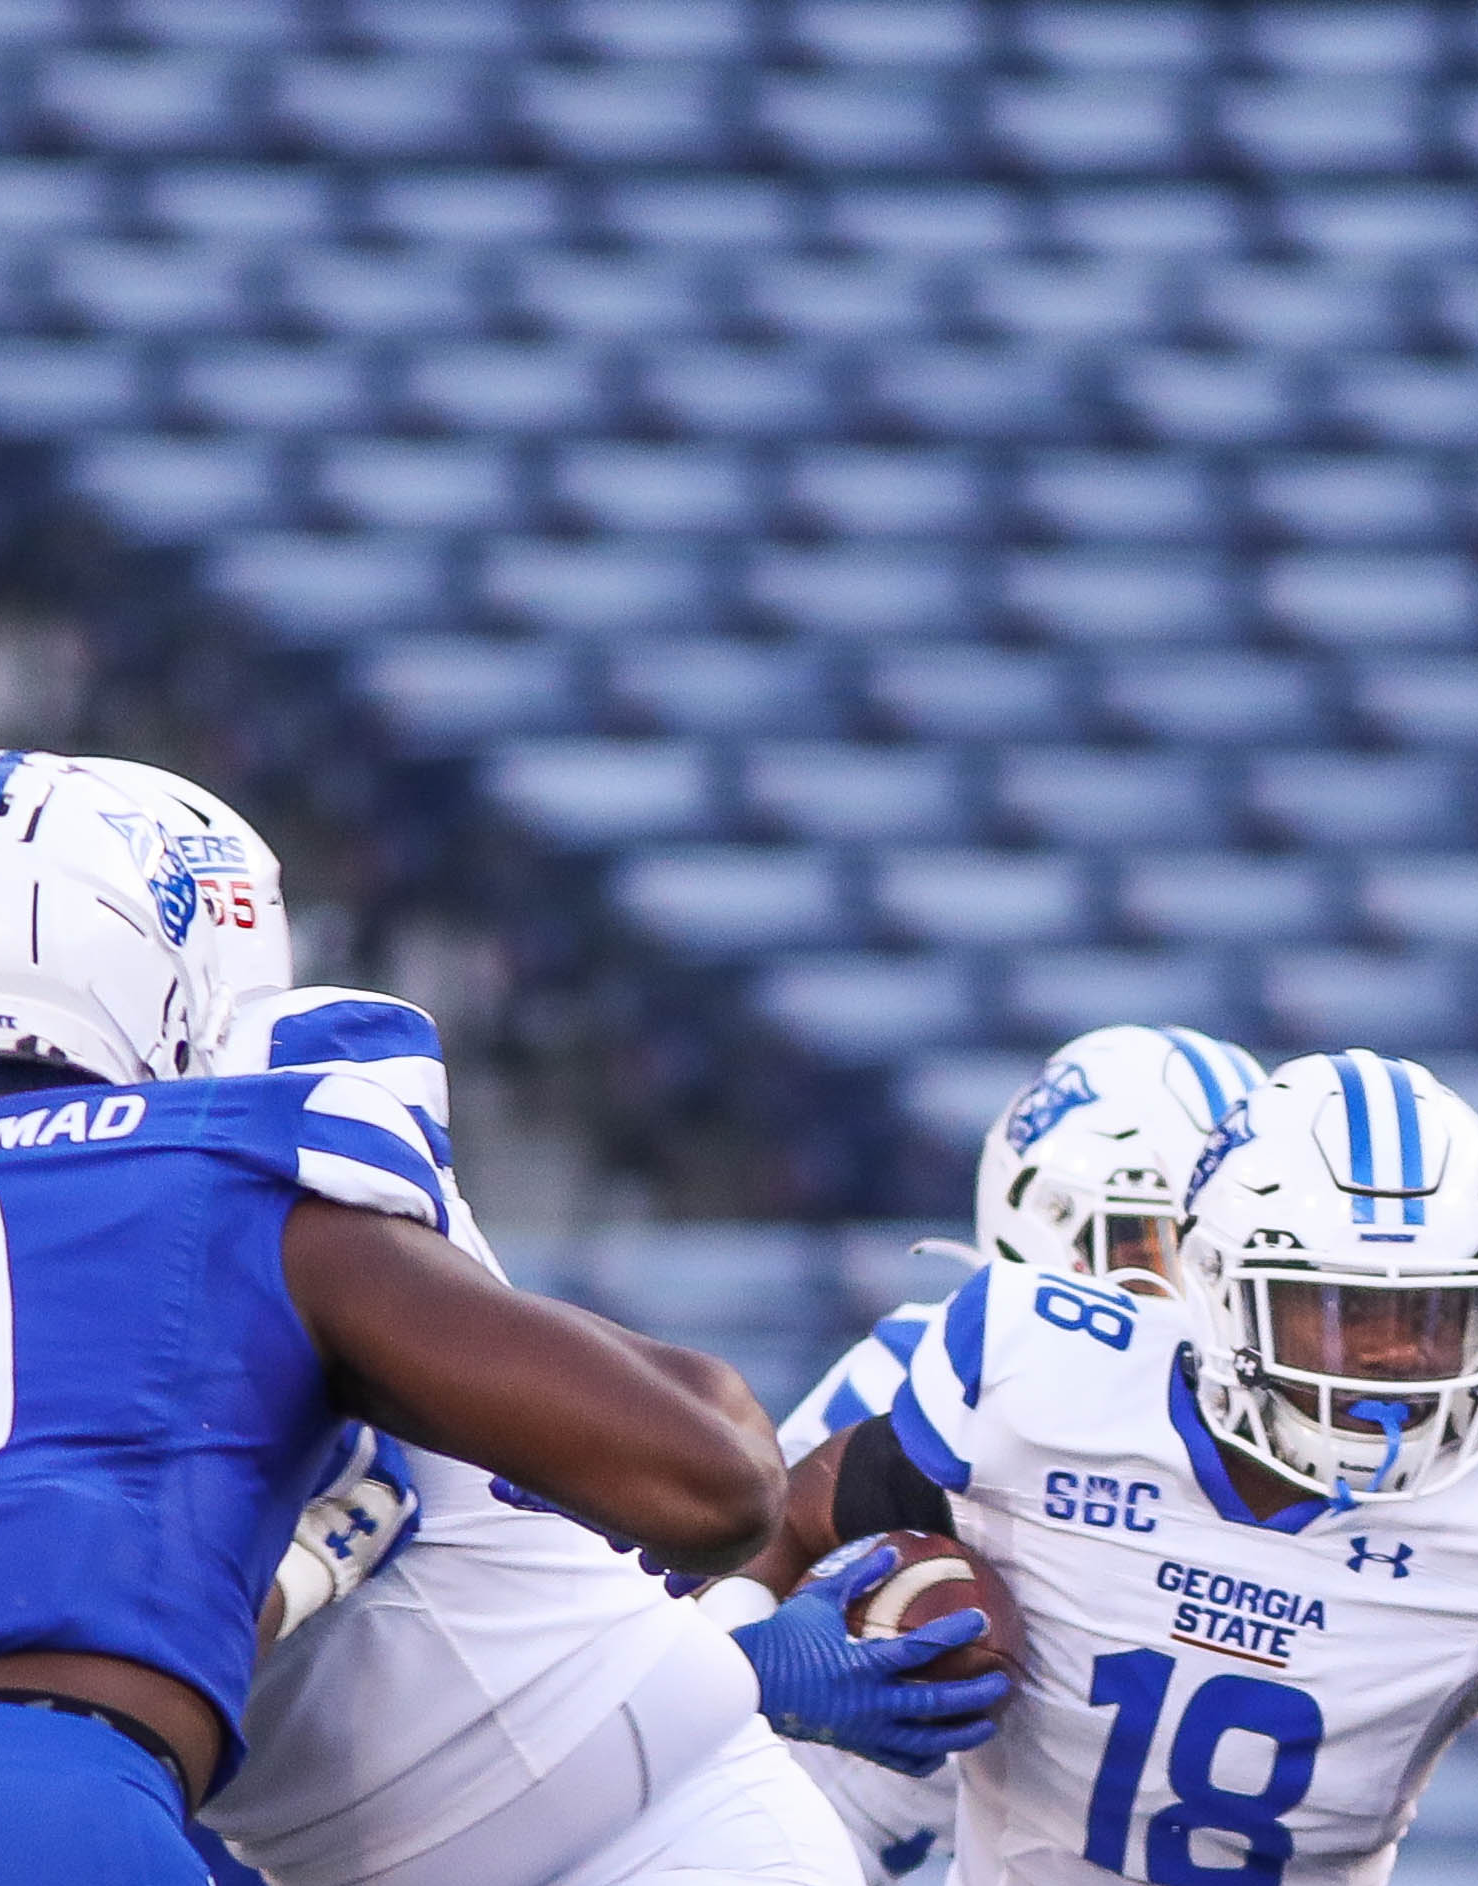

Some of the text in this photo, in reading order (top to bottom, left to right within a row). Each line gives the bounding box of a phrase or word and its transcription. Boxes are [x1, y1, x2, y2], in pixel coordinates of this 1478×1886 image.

[1045, 1470, 1160, 1533] SBC
[1157, 1561, 1327, 1630] GEORGIA
[1174, 1602, 1296, 1658] STATE
